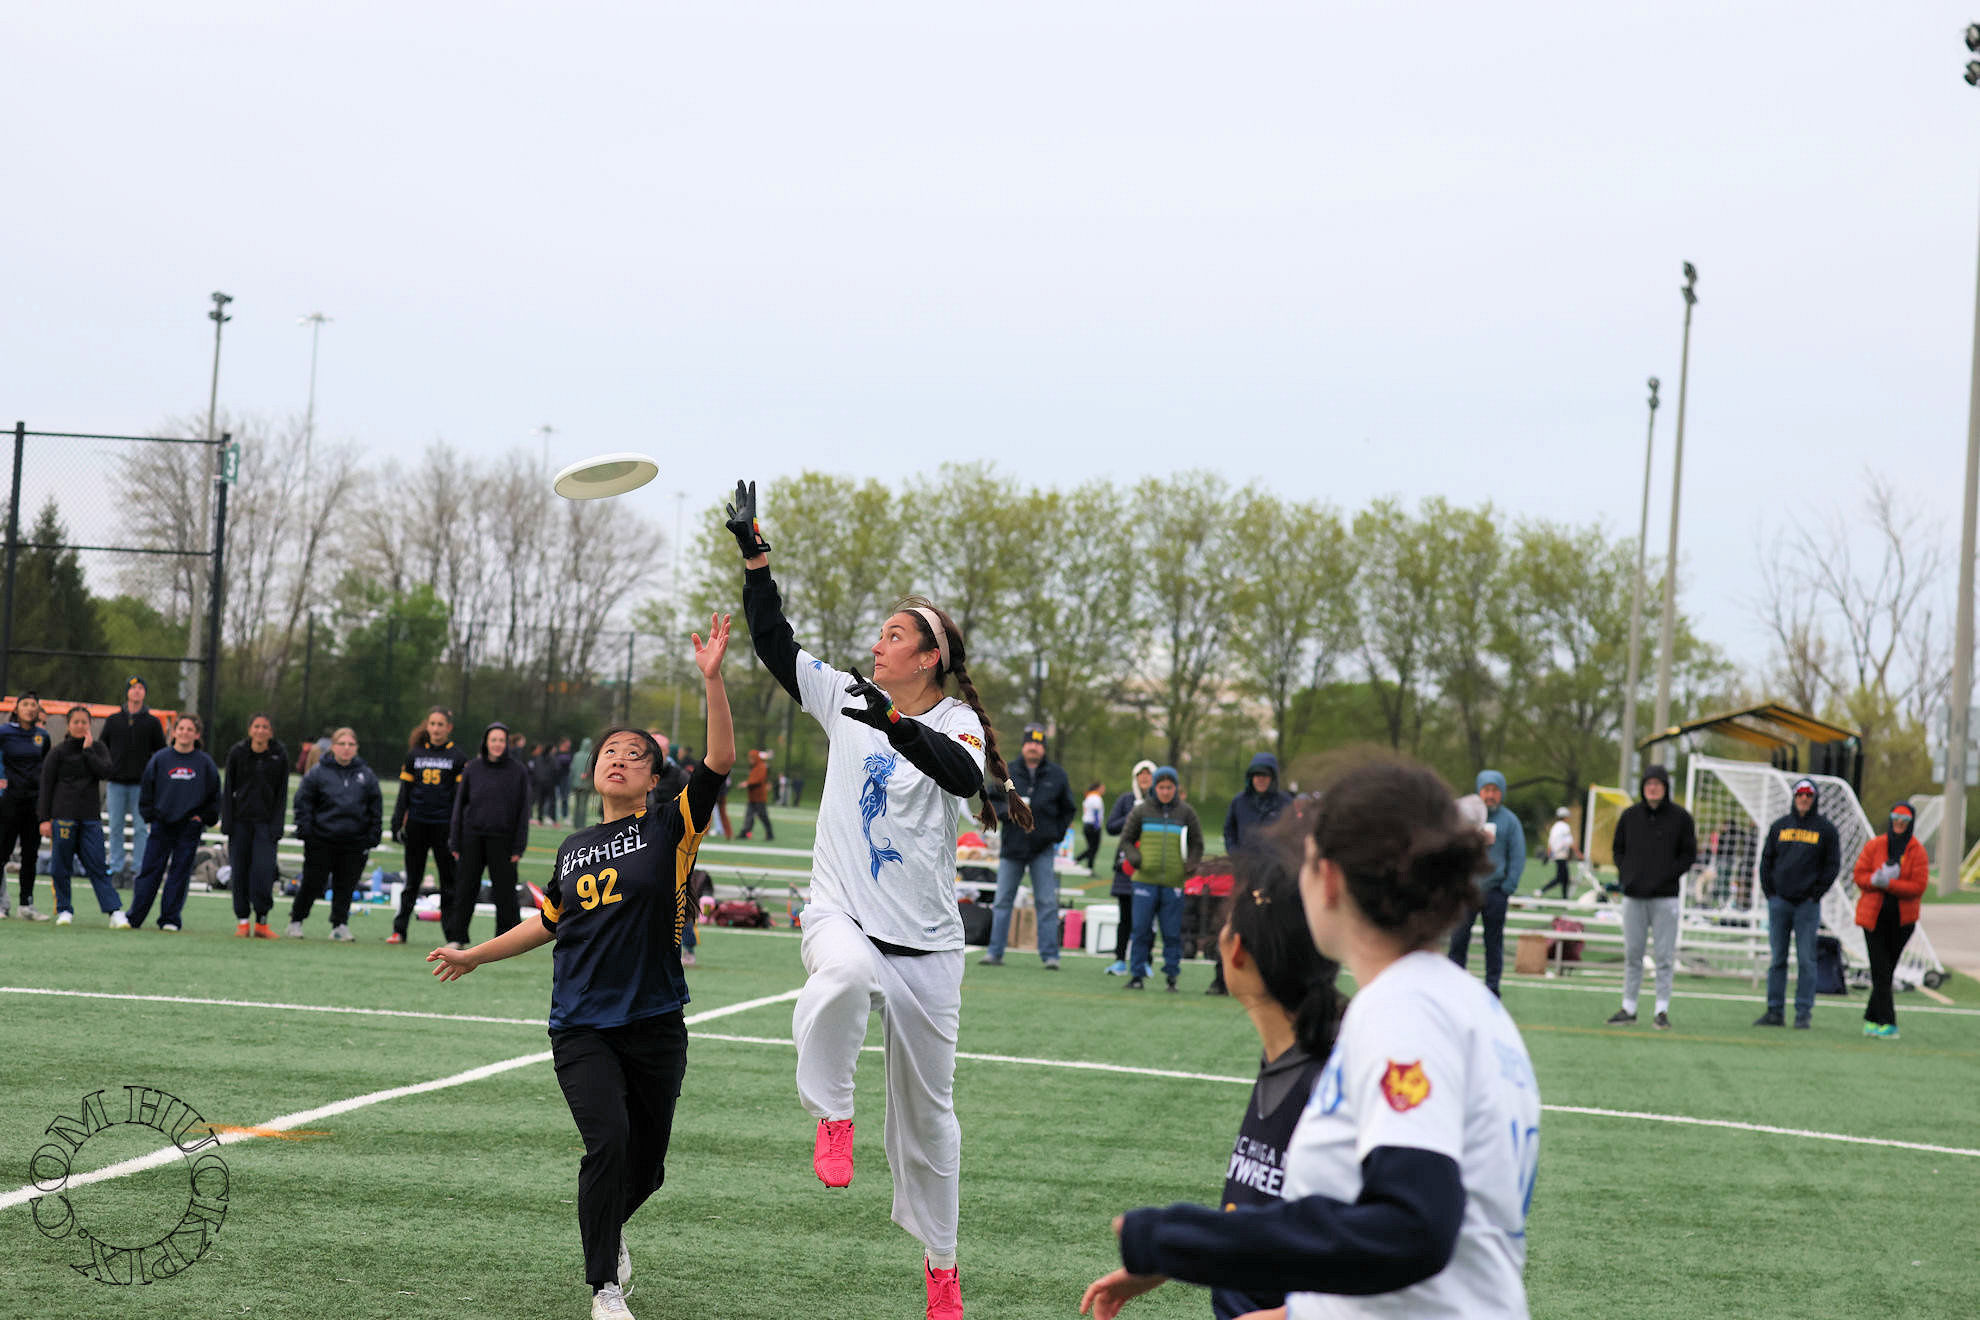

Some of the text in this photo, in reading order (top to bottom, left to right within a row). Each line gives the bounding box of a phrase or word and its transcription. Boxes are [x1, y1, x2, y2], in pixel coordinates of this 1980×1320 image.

[227, 451, 236, 477] 3
[422, 768, 441, 785] 95
[576, 867, 623, 911] 92
